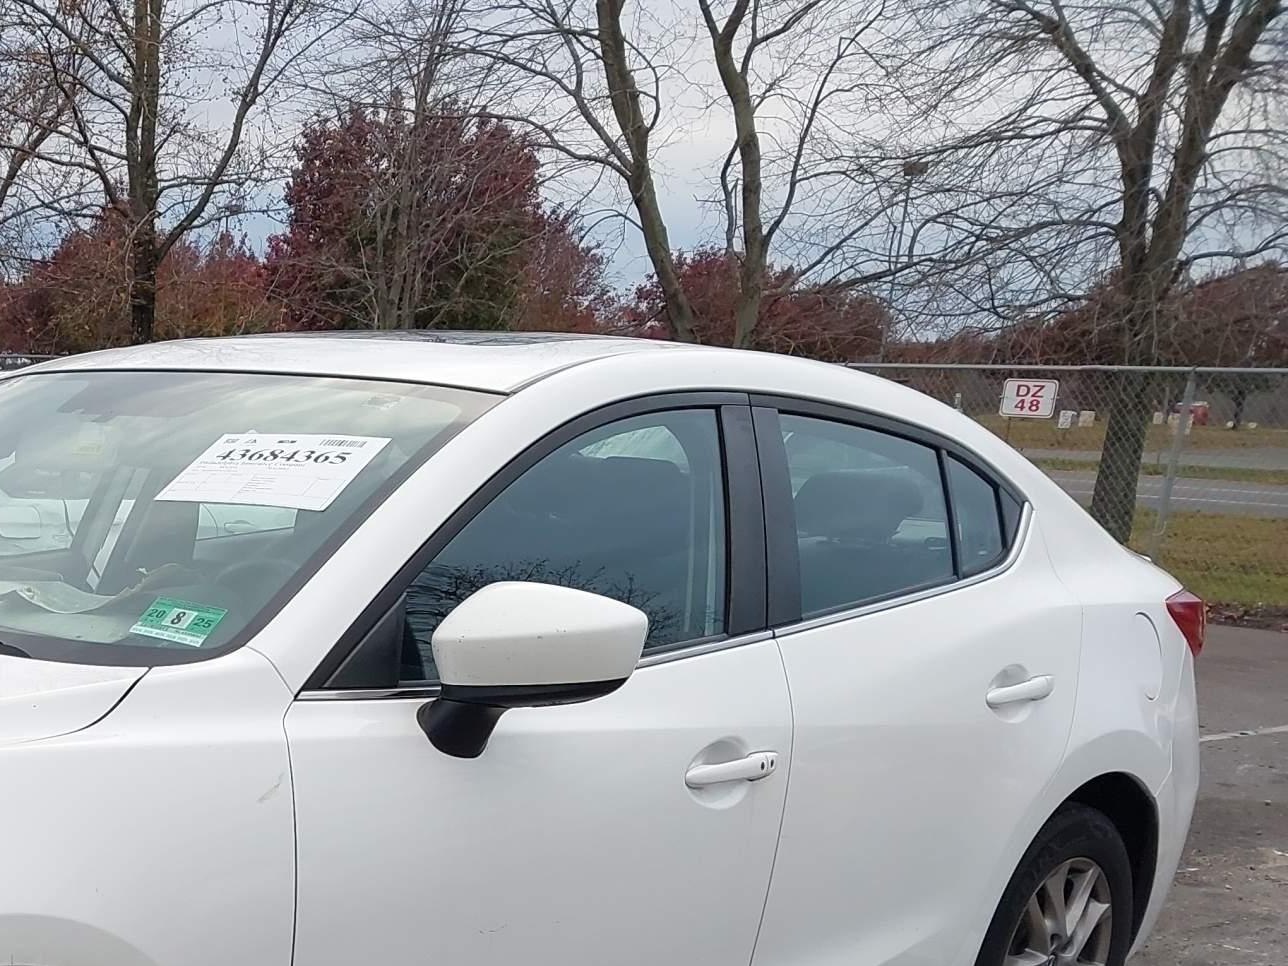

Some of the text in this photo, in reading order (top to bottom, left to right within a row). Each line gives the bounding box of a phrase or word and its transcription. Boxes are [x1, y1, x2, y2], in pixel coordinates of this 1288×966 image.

[1016, 384, 1045, 398] DZ
[1014, 398, 1041, 412] 48
[215, 448, 353, 464] 43684365
[147, 608, 214, 629] 20 8 25
